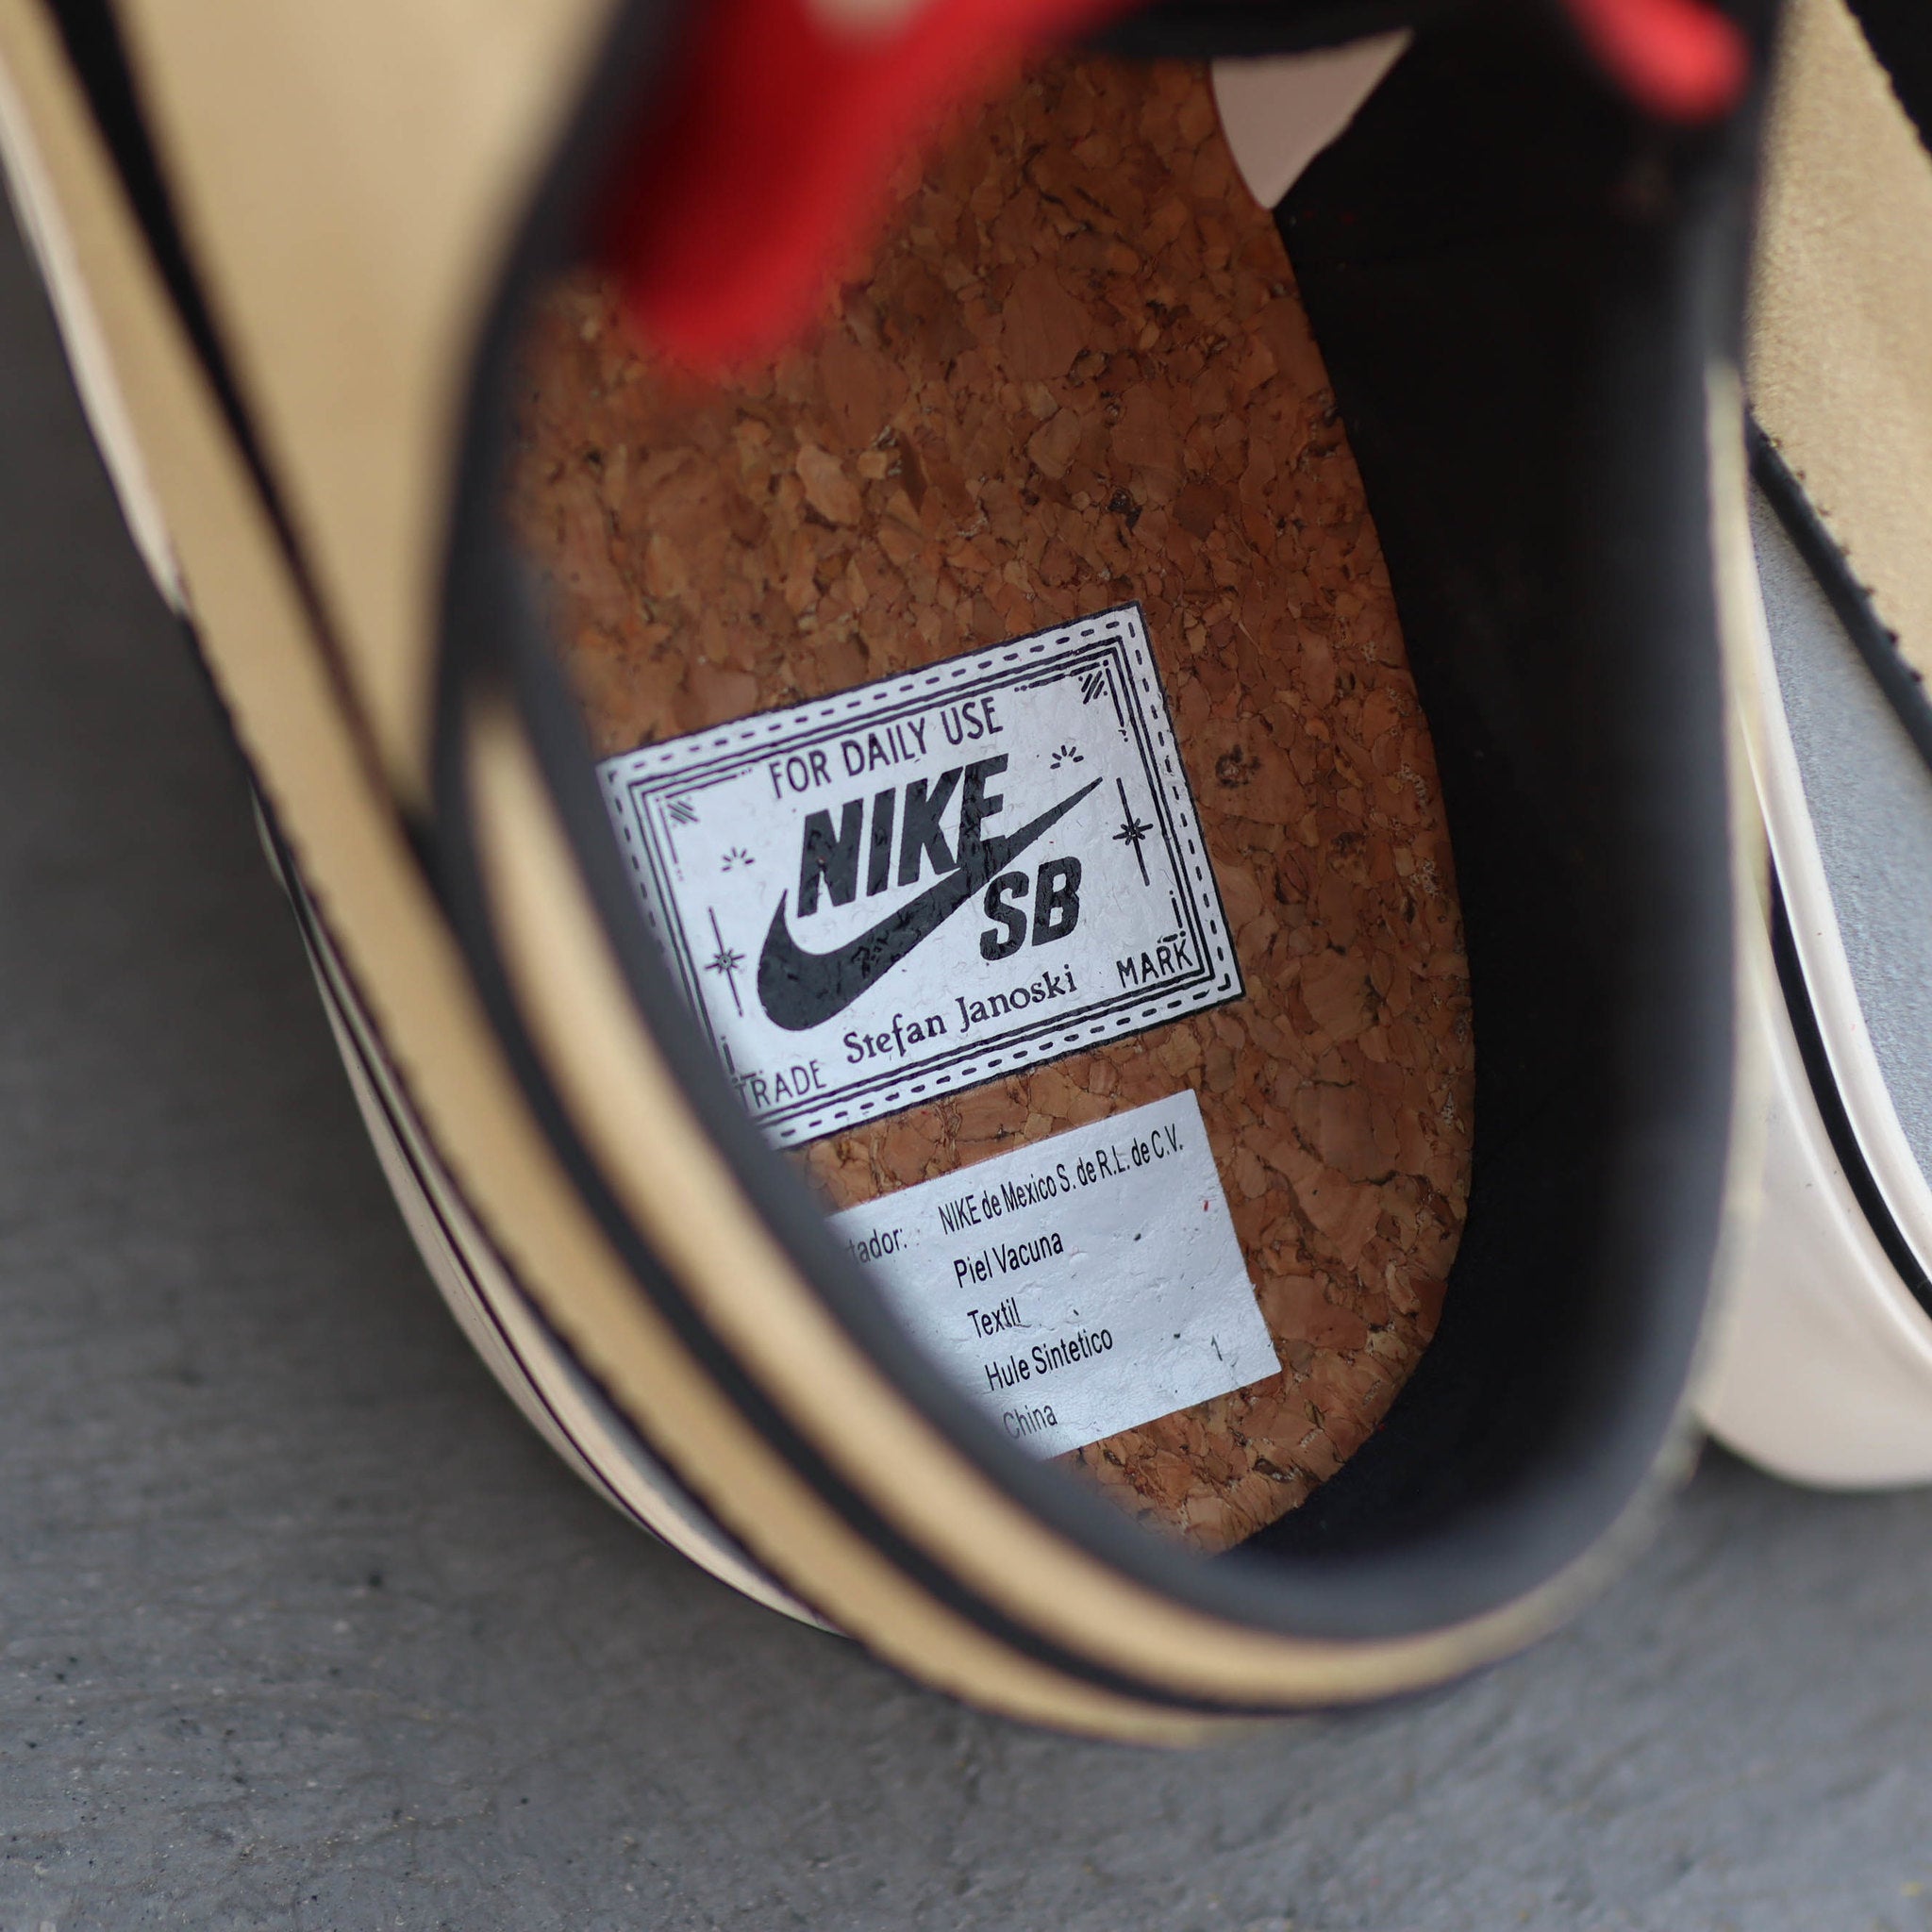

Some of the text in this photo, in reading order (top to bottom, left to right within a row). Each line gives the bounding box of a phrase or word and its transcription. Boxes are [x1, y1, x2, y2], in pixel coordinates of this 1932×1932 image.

[768, 696, 1004, 799] FOR DAILY USE
[796, 753, 1010, 919] NIKE
[979, 856, 1082, 962] SB
[1117, 939, 1192, 989] MARK
[842, 964, 1078, 1064] Stefan Janoski
[938, 1123, 1185, 1236] NIKE de Mexico S. de R.L. de C.V.
[953, 1230, 1065, 1289] Piel Vacuna
[967, 1296, 1022, 1340] Textil
[984, 1325, 1114, 1392] Hule Sintetico
[1002, 1402, 1058, 1441] China
